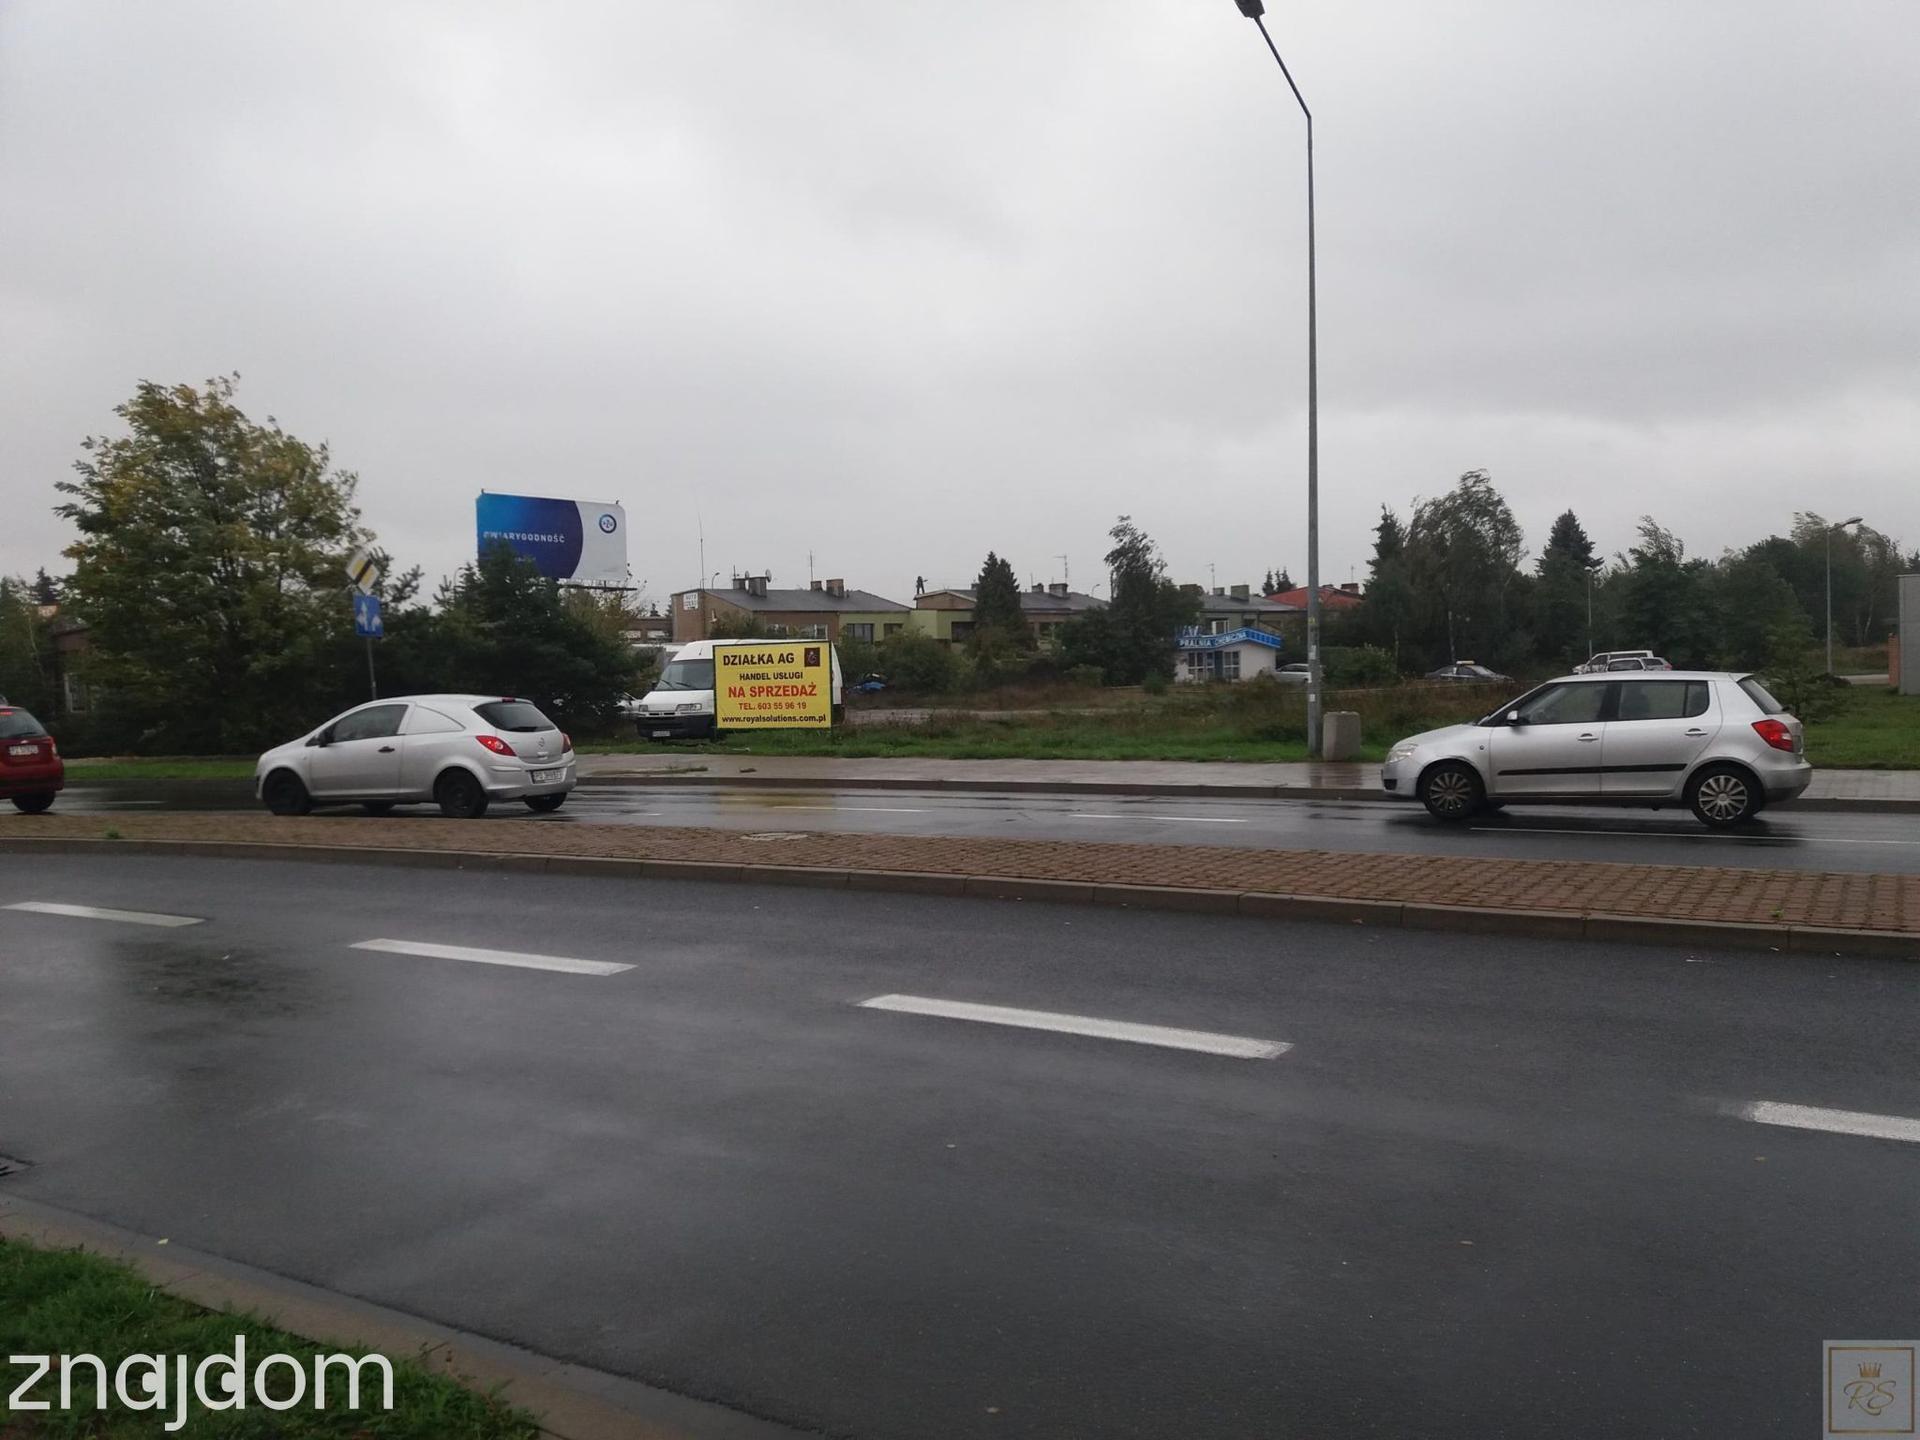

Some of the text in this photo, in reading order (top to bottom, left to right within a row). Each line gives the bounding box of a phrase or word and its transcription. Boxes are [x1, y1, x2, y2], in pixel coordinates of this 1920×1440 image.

[723, 652, 795, 666] DZIAŁKA AG
[739, 671, 803, 680] HANDEL USŁUGI
[728, 682, 817, 698] NA SPRZEDAŻ
[739, 703, 756, 711] TEL.
[758, 702, 772, 710] 603
[774, 702, 783, 710] 55
[785, 702, 795, 710] 96
[722, 713, 826, 724] www.royalsolutions.com.pl
